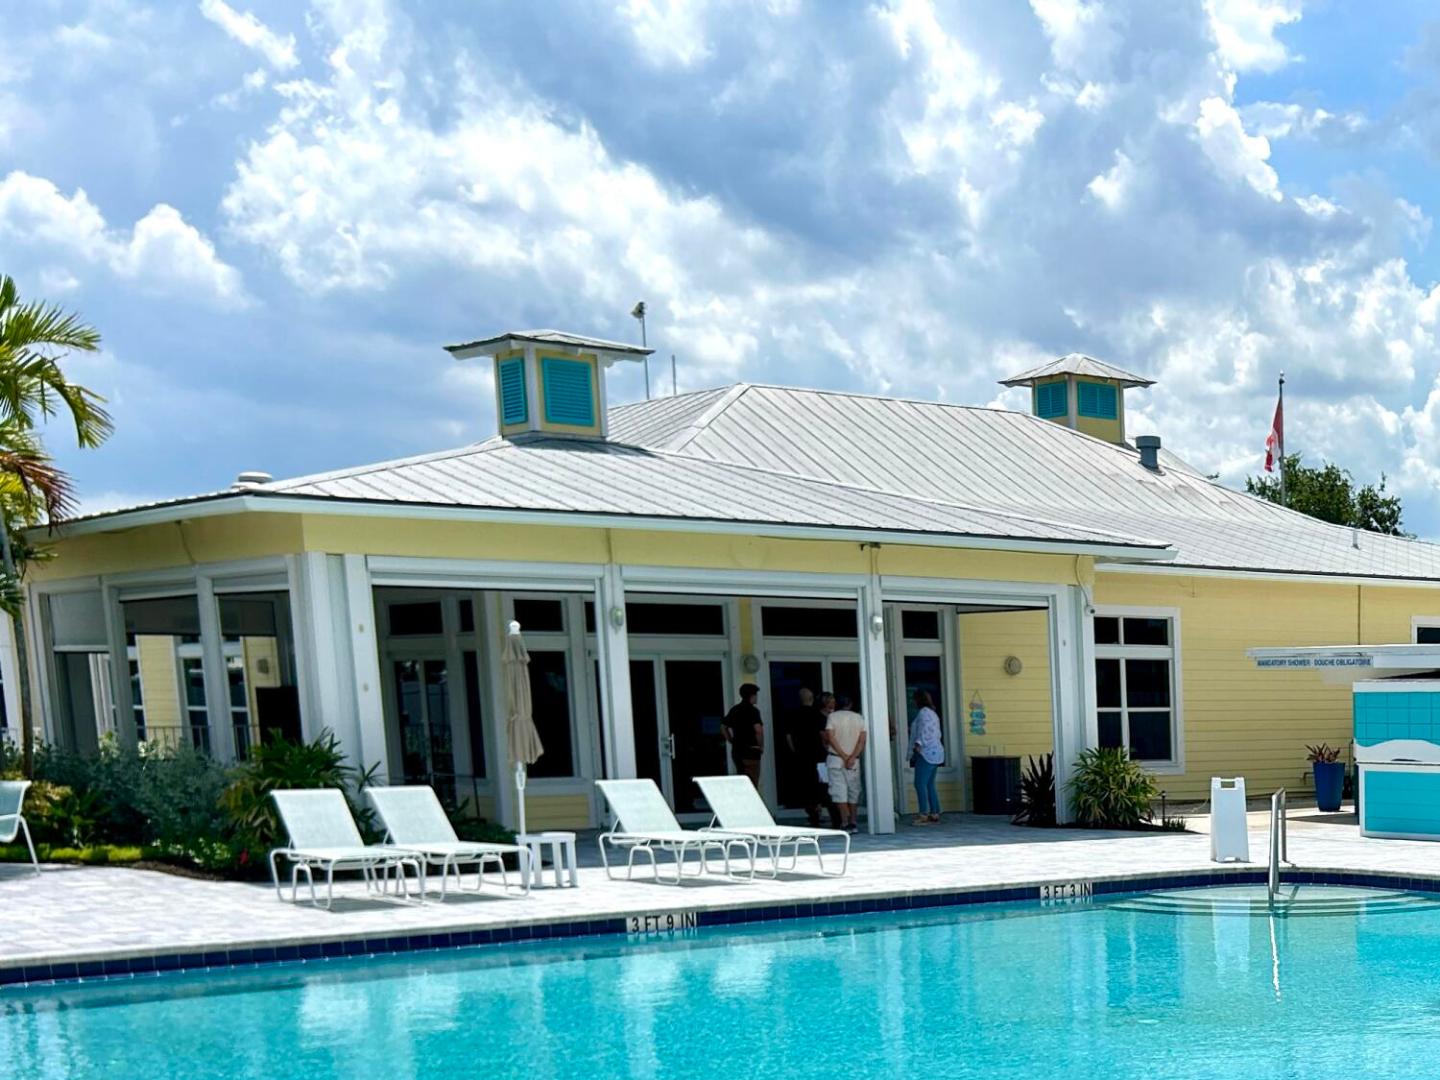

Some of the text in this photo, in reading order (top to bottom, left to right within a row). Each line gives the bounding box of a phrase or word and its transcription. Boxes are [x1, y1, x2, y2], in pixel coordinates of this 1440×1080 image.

[1288, 658, 1310, 666] SHOWER
[1314, 658, 1334, 666] DOUCHE
[1044, 882, 1091, 898] 3 FT 3 IN
[632, 912, 695, 932] 3 FT 9 IN
